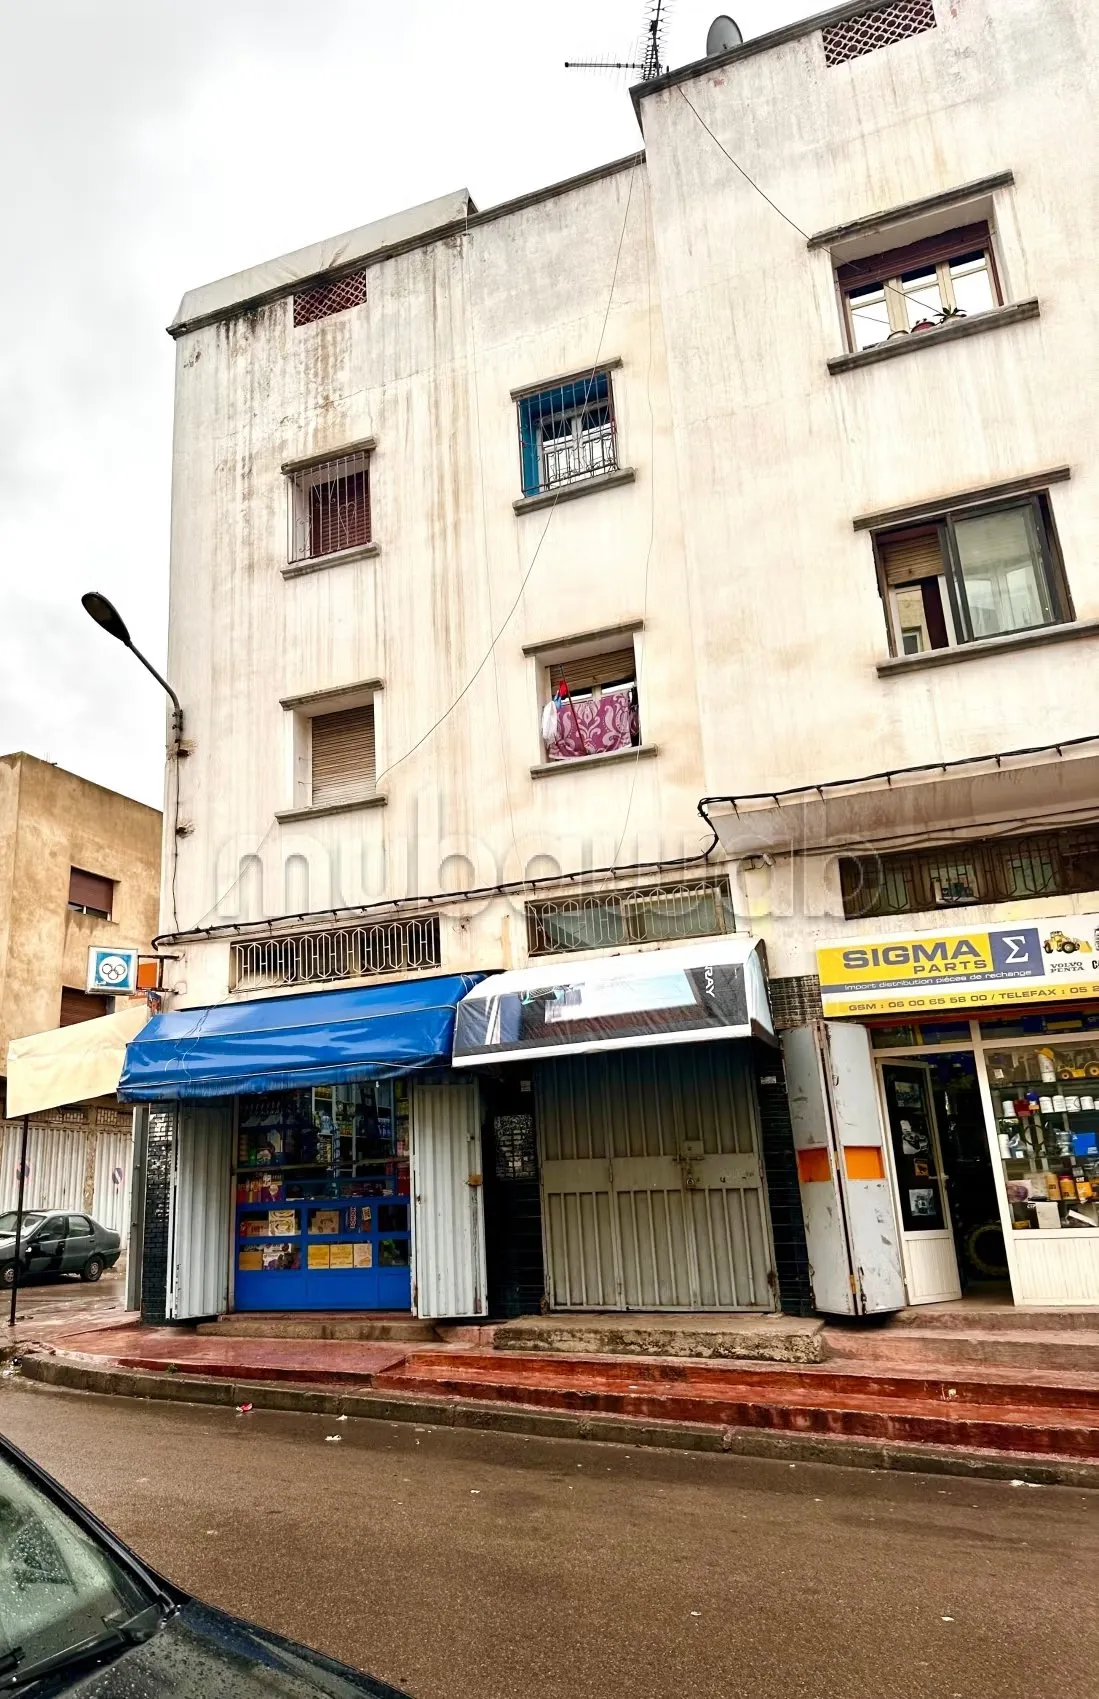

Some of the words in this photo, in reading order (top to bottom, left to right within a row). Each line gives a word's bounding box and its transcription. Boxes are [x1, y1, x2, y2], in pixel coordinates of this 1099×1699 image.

[842, 939, 981, 969] SIGMA
[913, 959, 987, 975] PARTS
[844, 983, 877, 991] import
[878, 978, 933, 988] distribution
[985, 969, 1032, 979] rechange
[848, 1003, 877, 1011] GSM
[908, 999, 925, 1007] 00
[970, 994, 988, 1002] 00
[998, 988, 1057, 999] TELEFAX
[1070, 986, 1088, 994] 05
